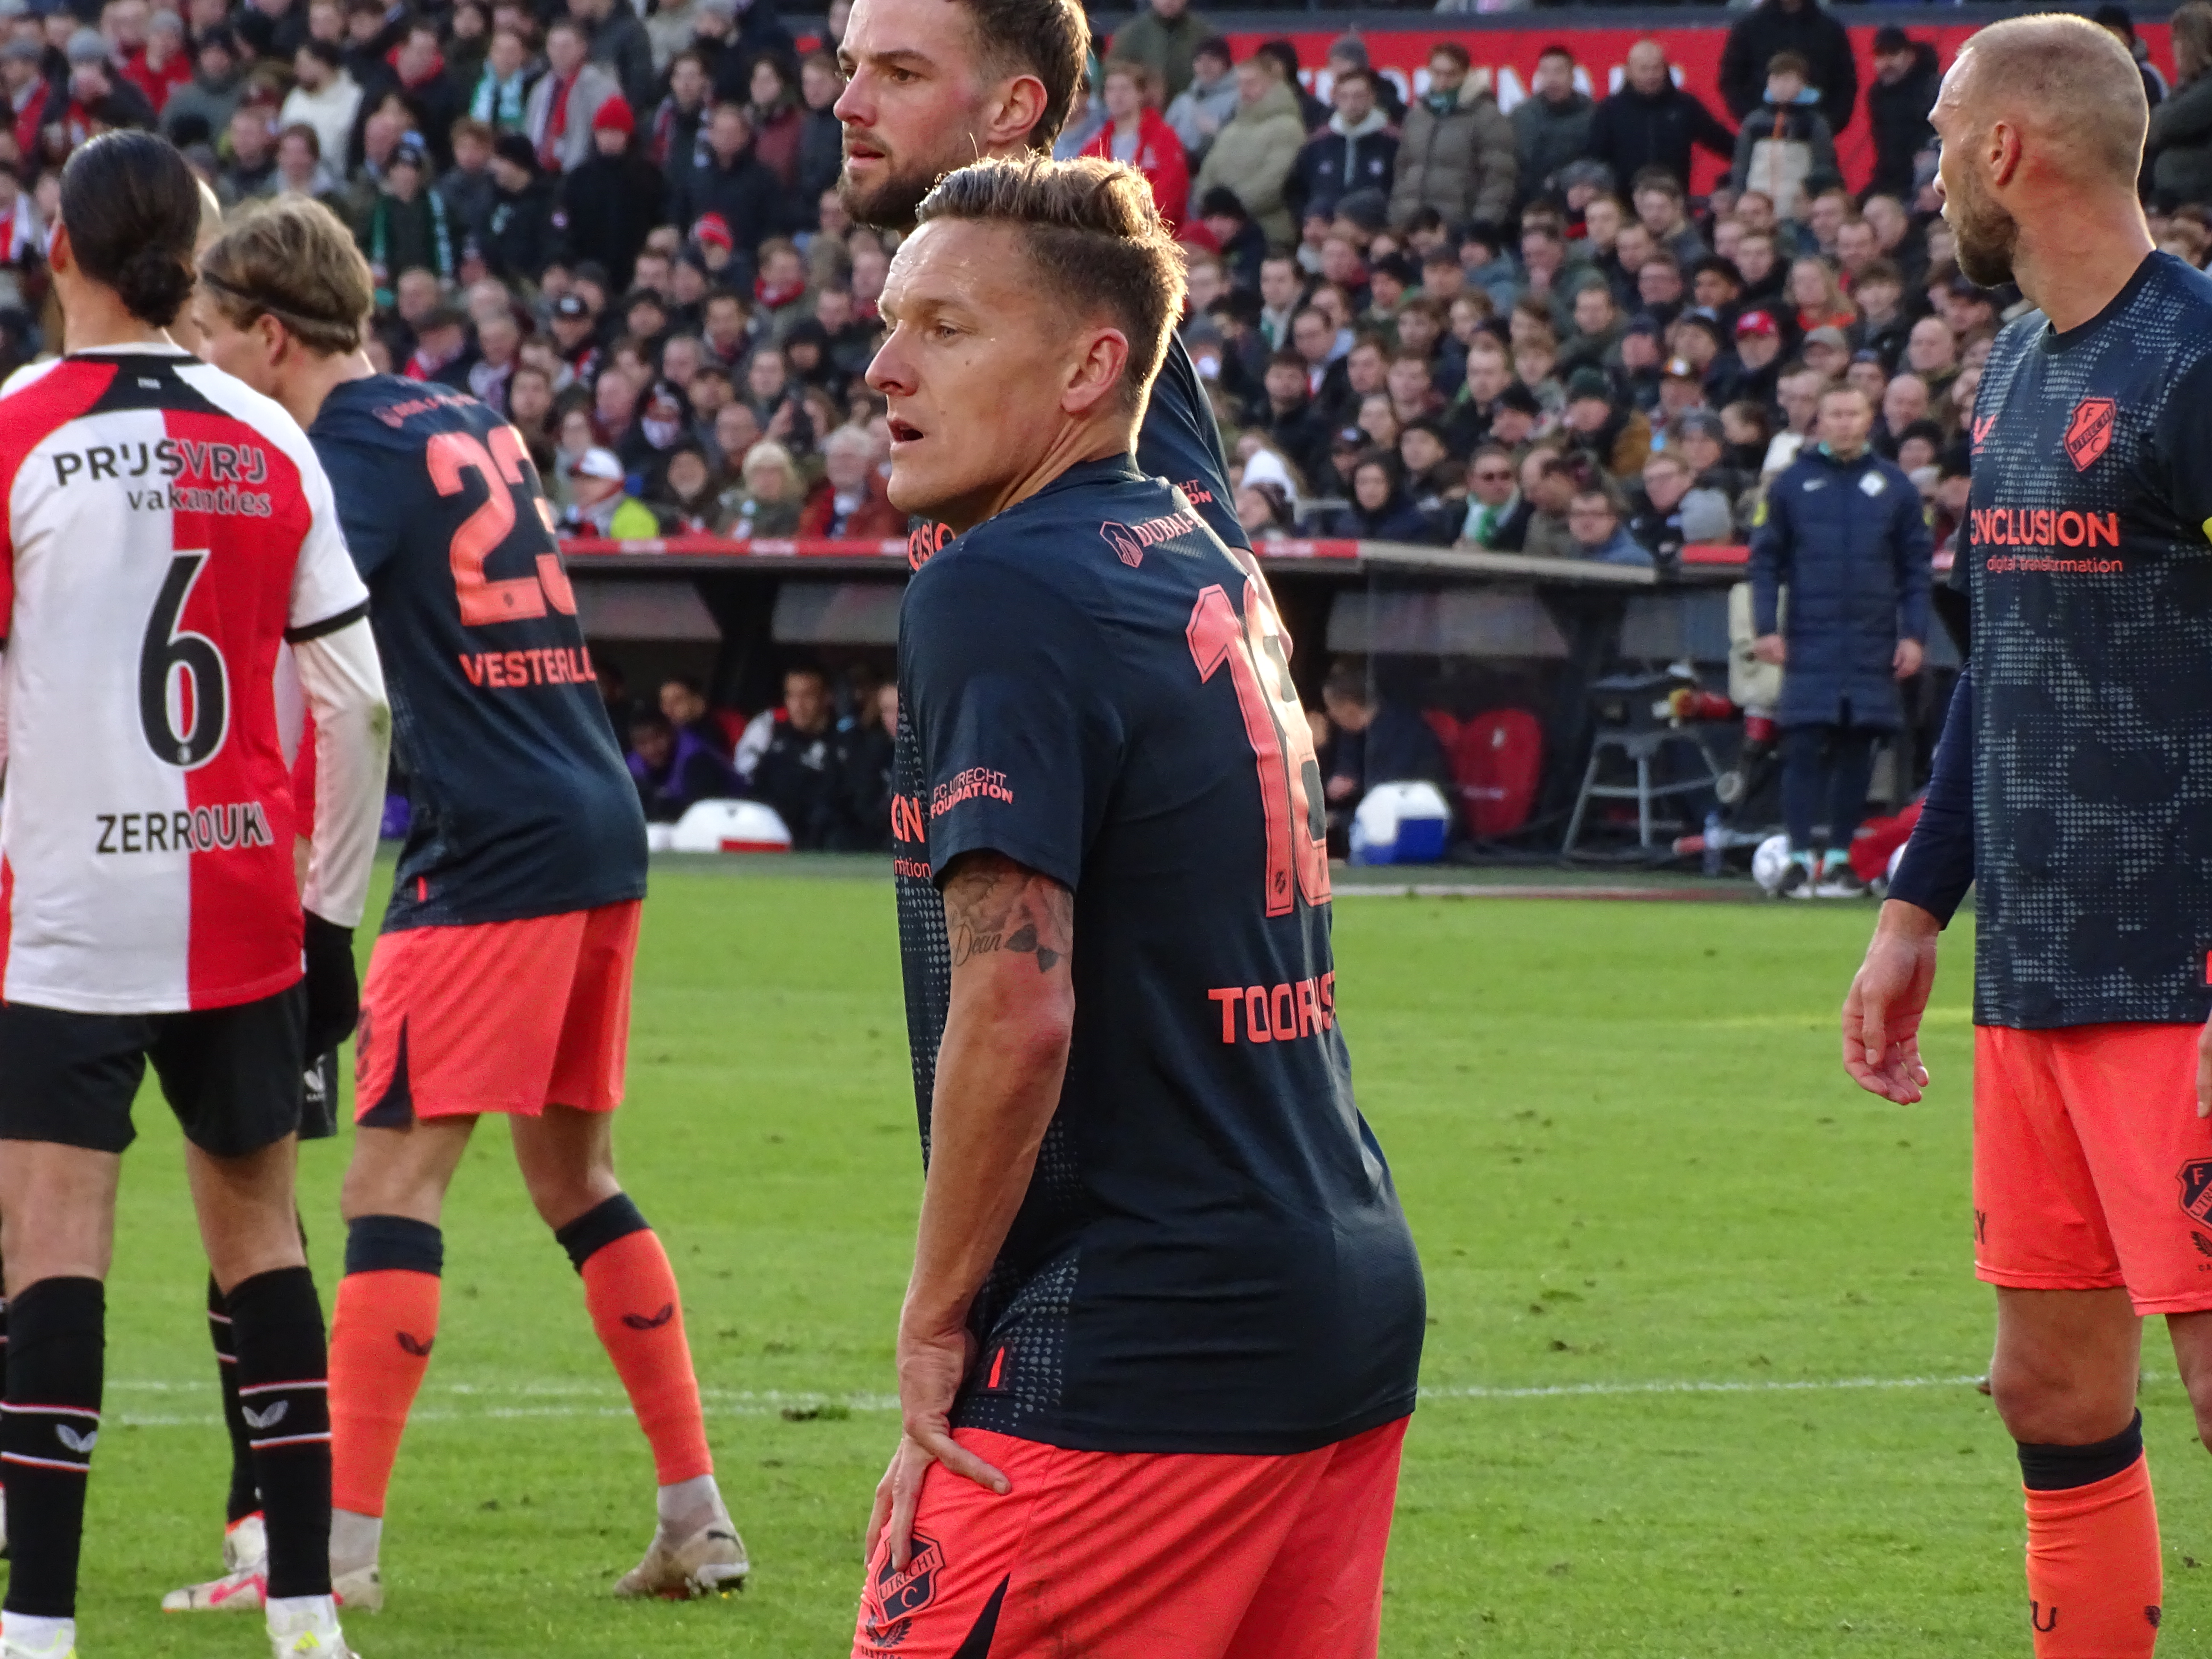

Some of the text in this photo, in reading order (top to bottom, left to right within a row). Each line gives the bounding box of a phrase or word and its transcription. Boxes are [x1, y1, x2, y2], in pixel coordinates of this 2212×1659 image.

[128, 481, 271, 517] vakanties
[426, 425, 578, 626] 23
[139, 548, 230, 771] 6
[1185, 573, 1332, 918] 18
[930, 781, 1014, 820] FOUNDATION
[933, 766, 1007, 802] FC UTRECHT
[96, 801, 274, 854] ZERROUK
